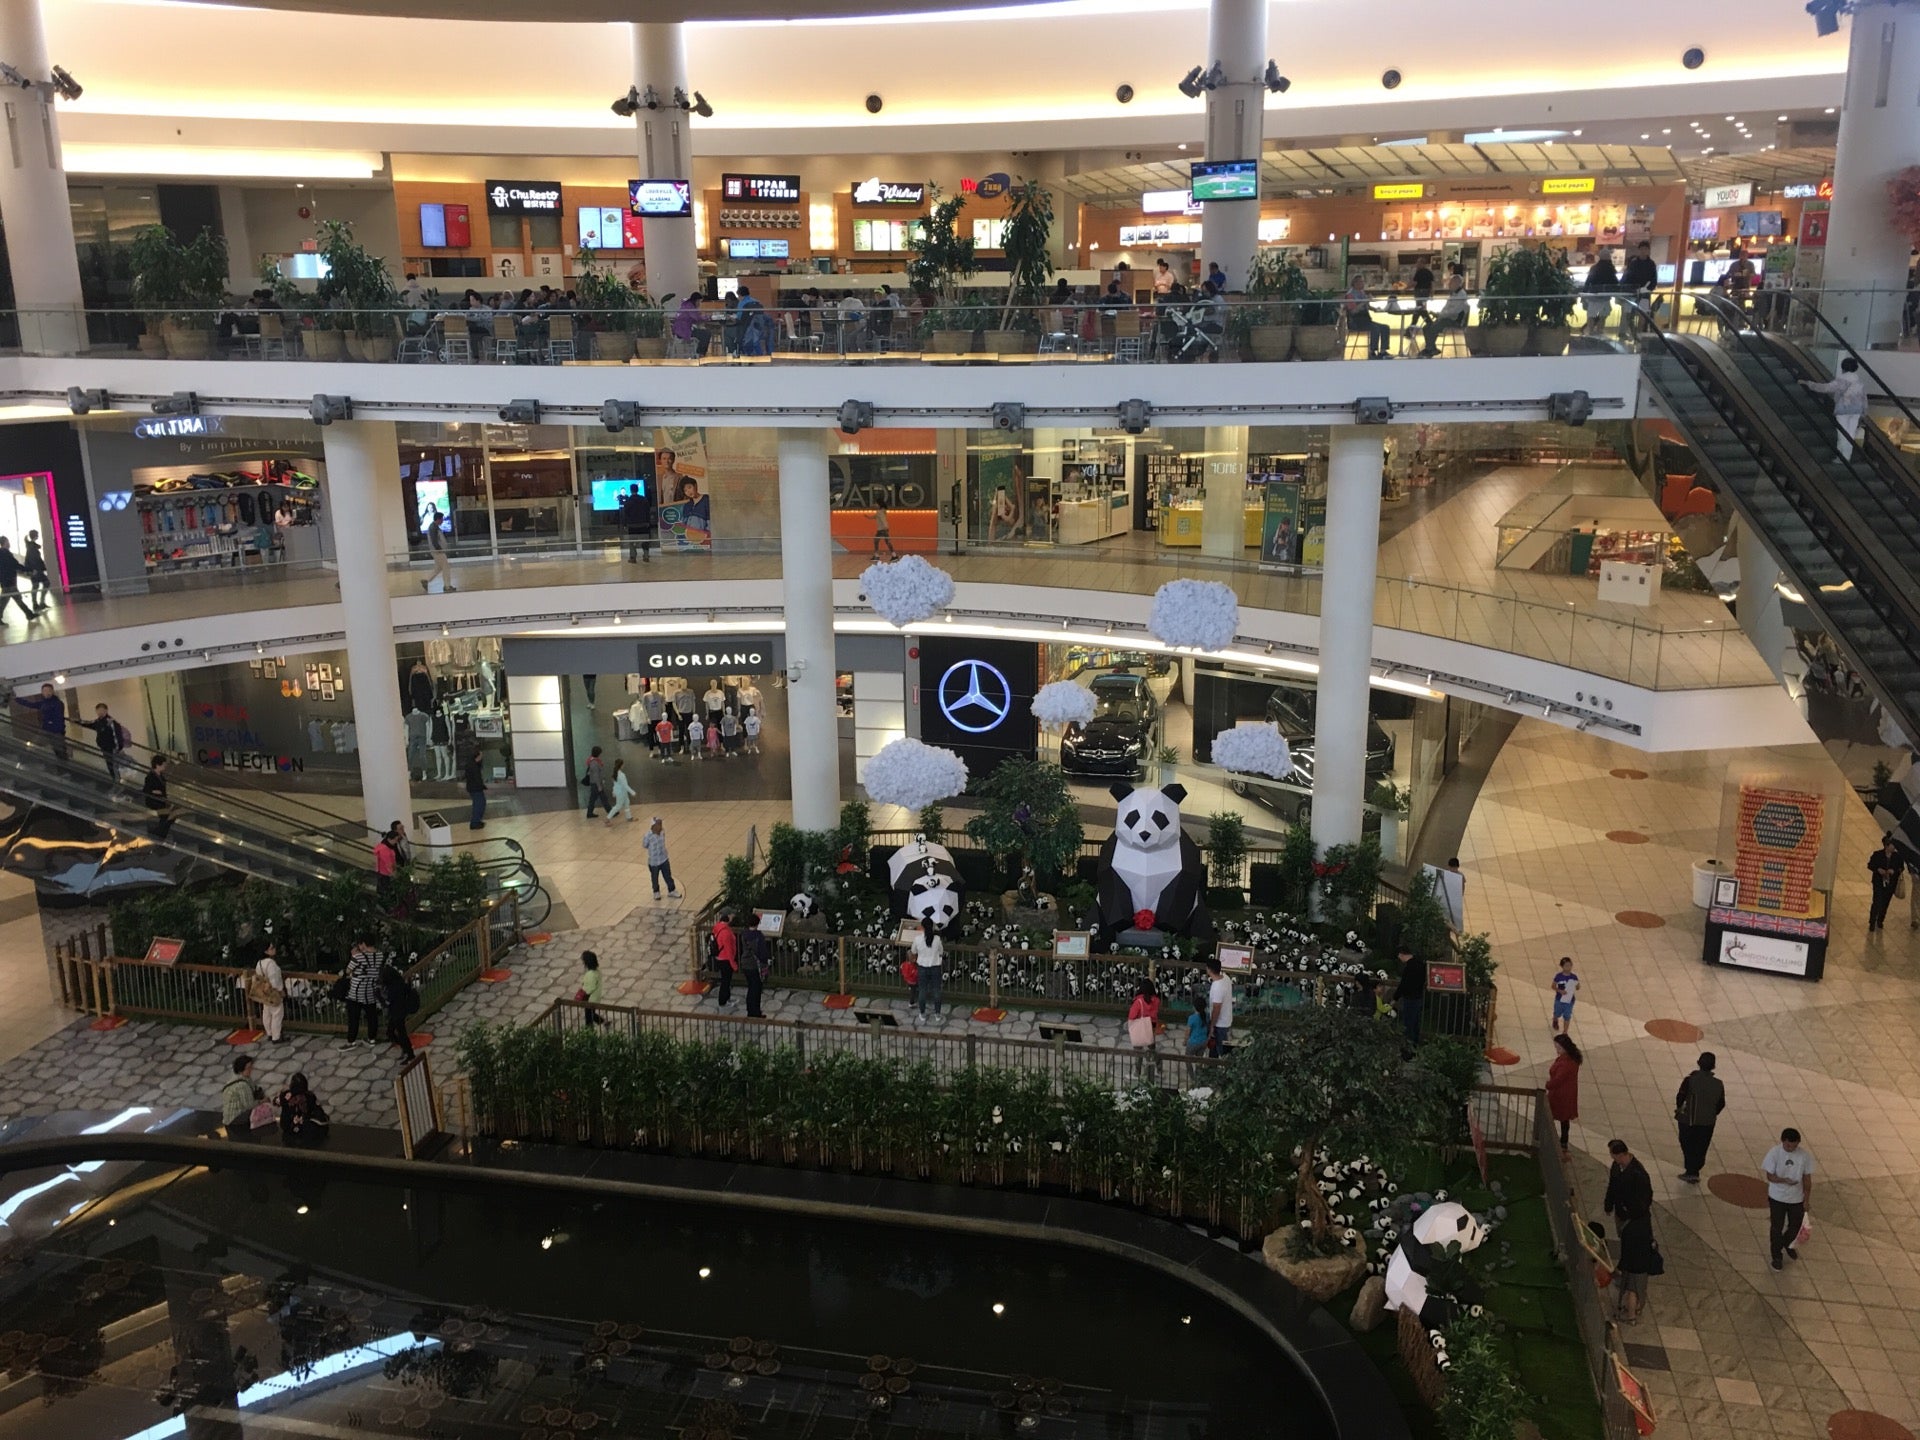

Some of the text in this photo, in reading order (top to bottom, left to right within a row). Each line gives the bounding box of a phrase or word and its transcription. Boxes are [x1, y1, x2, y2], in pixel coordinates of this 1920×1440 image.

[743, 179, 787, 189] TEPPAN
[750, 188, 798, 198] KITCHEN
[180, 442, 192, 453] By
[649, 652, 762, 669] GIORDANO
[194, 726, 266, 747] SPECIAL
[197, 748, 304, 773] COLLECTION
